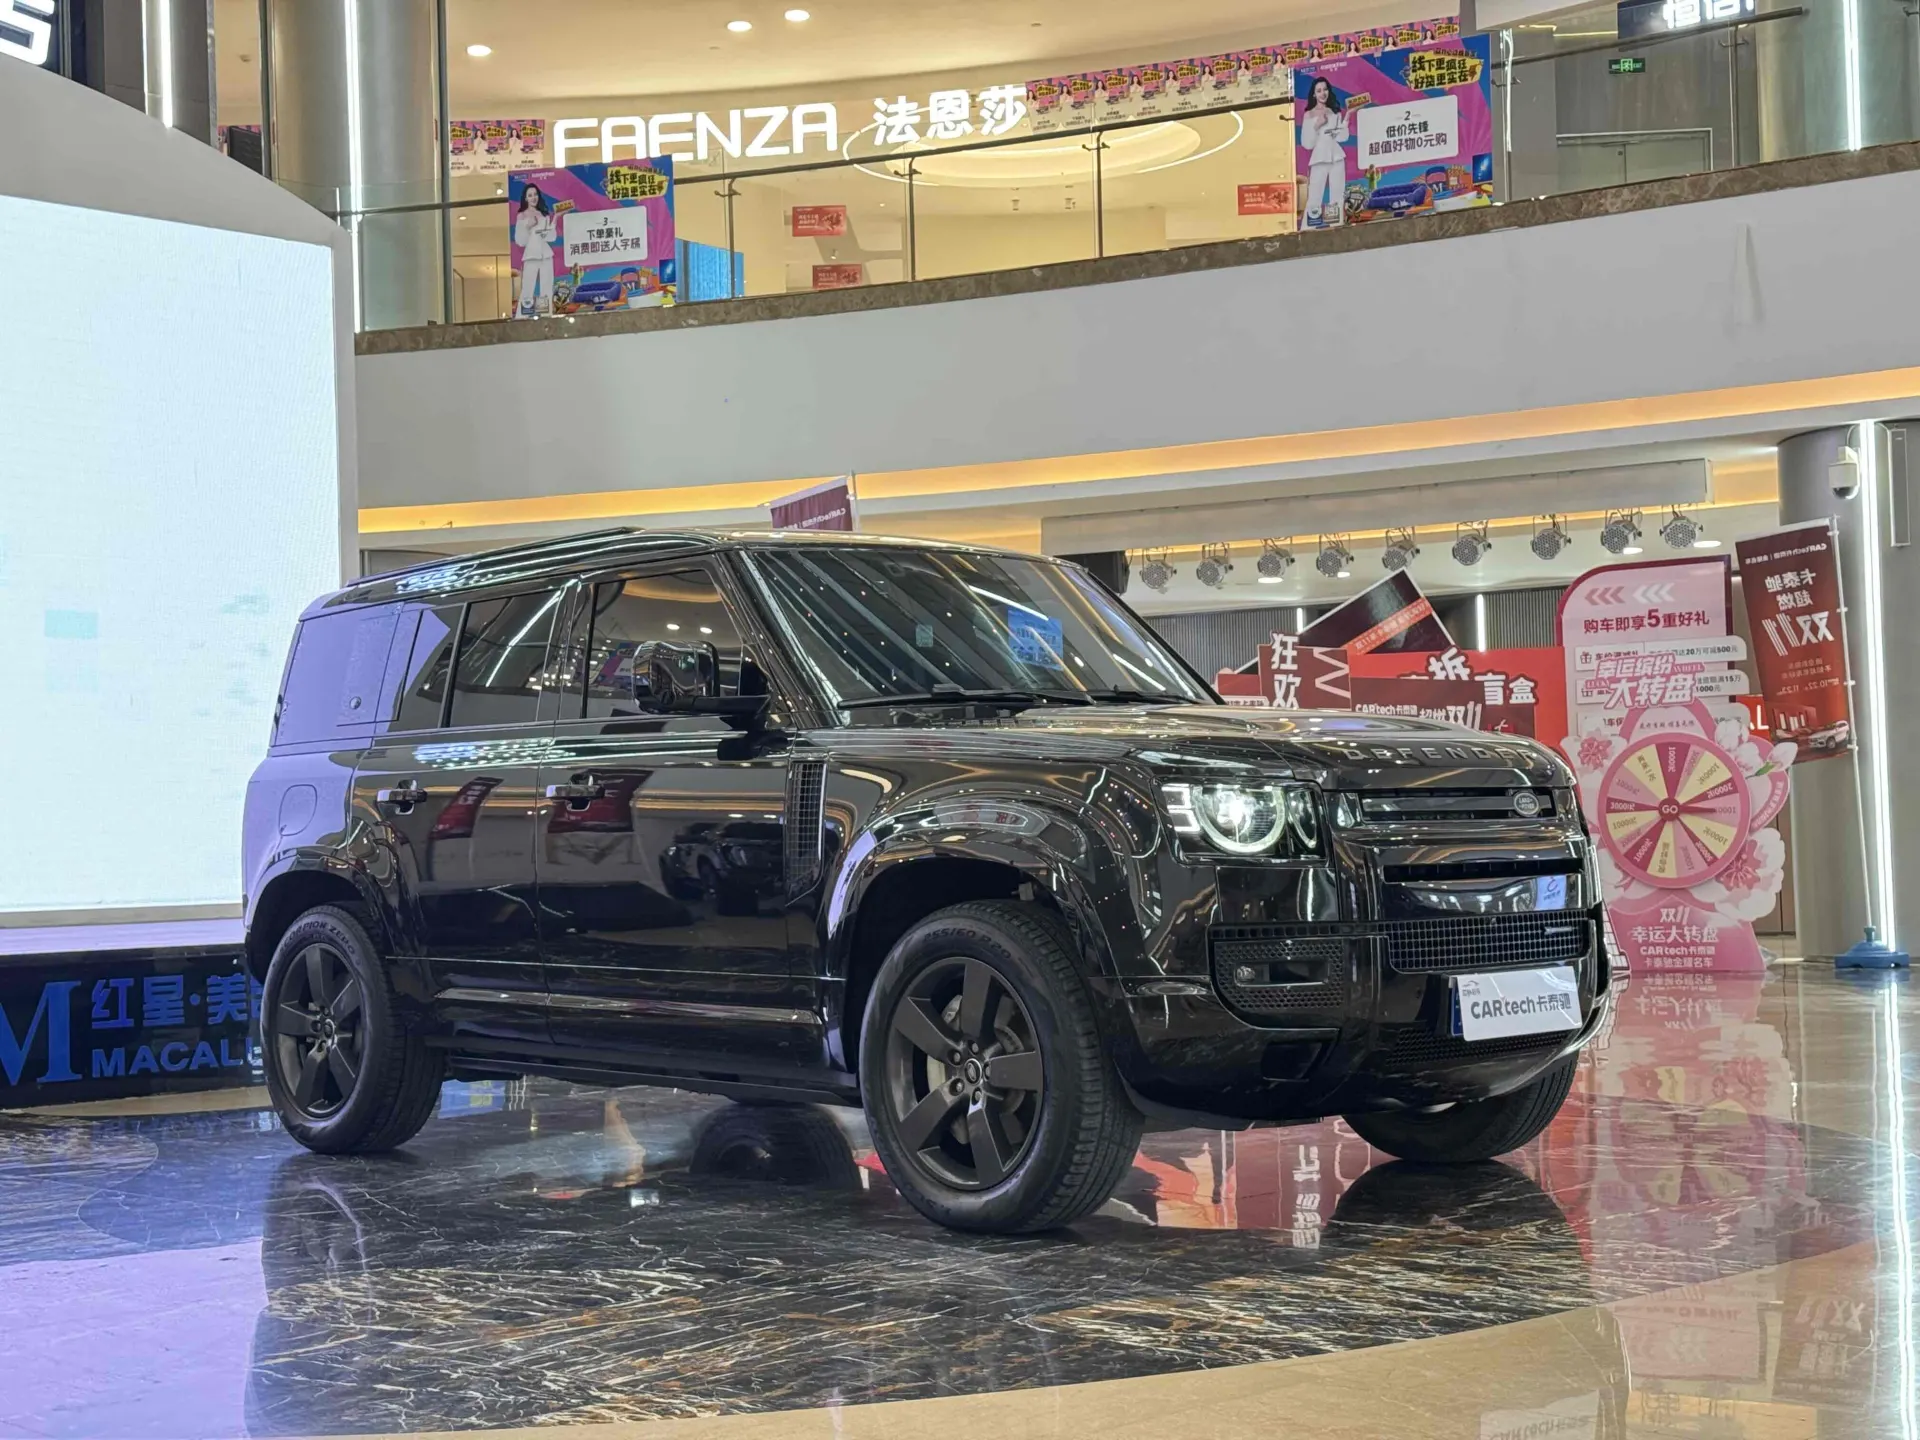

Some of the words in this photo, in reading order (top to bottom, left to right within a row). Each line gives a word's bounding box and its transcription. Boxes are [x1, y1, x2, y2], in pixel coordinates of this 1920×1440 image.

[1411, 55, 1467, 73] 线下更疯狂
[1404, 111, 1411, 121] 2
[553, 102, 838, 168] FAENZA
[873, 84, 1027, 146] 法恩莎
[1385, 120, 1429, 139] 低价先锋
[1368, 132, 1447, 156] 超值好物0元购
[609, 170, 656, 184] 线下更疯狂
[603, 217, 608, 226] 3
[587, 227, 623, 240] 下单豪礼
[1584, 609, 1710, 634] 购车即享5重好礼
[1599, 656, 1674, 677] 幸运缤纷
[1604, 674, 1695, 710] 大转盘
[1345, 747, 1536, 761] DEFENDER
[1662, 804, 1679, 814] GO
[1660, 905, 1690, 925] 双11
[1631, 925, 1719, 943] 幸运大转盘
